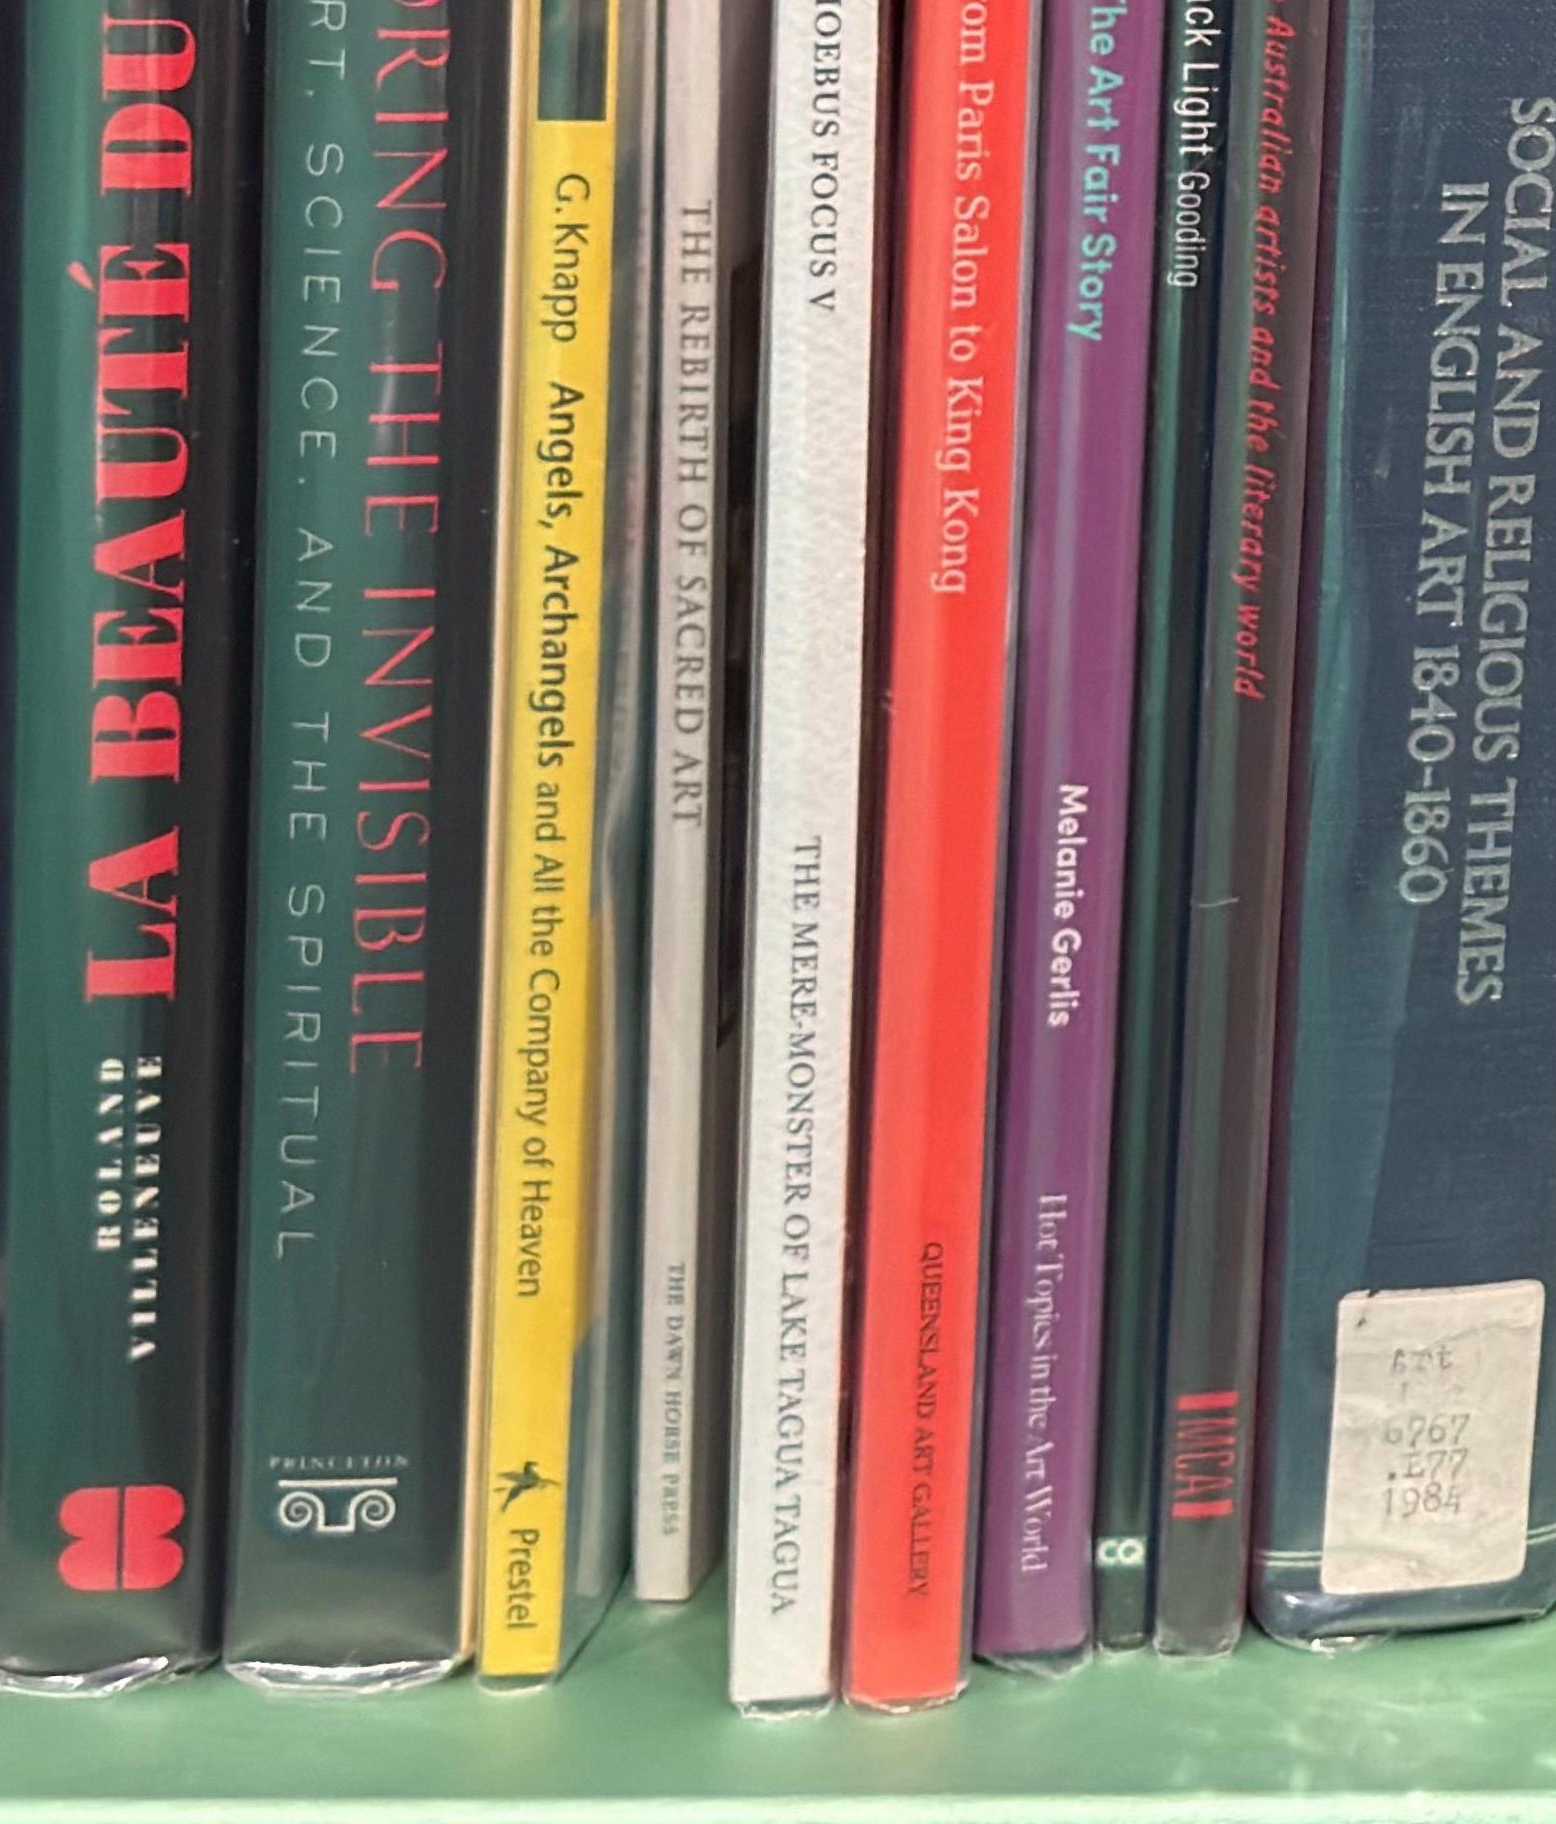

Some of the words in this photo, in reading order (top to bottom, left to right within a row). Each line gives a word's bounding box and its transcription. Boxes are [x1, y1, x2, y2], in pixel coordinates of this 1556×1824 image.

[101, 18, 195, 195] DU
[1085, 70, 1124, 130] Art
[1174, 60, 1216, 157] Light
[555, 174, 591, 214] G.
[680, 201, 710, 284] THE
[809, 152, 839, 278] FOCUS
[1083, 145, 1120, 221] Fair
[1168, 171, 1210, 287] Gooding
[1440, 182, 1488, 245] IN
[1500, 97, 1556, 307] SOCIAL
[542, 223, 588, 343] Knapp
[808, 290, 835, 312] V
[1070, 234, 1116, 342] Story
[365, 343, 441, 536] THE
[678, 303, 710, 484] REBIRTH
[1424, 262, 1482, 496] ENGLISH
[1493, 326, 1543, 458] AND
[67, 243, 190, 783] BEAUTÉ
[678, 502, 707, 552] OF
[1416, 517, 1466, 626] ART
[295, 529, 334, 668] AND
[675, 576, 707, 735] SACRED
[1473, 474, 1533, 762] RELIGIOUS
[290, 712, 328, 841] THE
[351, 587, 436, 1074] INVISIBLE
[673, 756, 705, 827] ART
[1397, 645, 1460, 905] 1840-1860
[85, 827, 179, 1001] LA
[793, 837, 821, 911] THE
[1056, 783, 1087, 919] Melanie
[1456, 780, 1515, 1005] THEMES
[1048, 927, 1082, 1027] Gerlis
[277, 886, 324, 1259] SPIRITUAL
[780, 922, 819, 1203] MERE-MONSTER
[97, 1057, 124, 1251] ROLAND
[130, 1055, 161, 1358] VILLENEUVE
[781, 1213, 812, 1259] OF
[780, 1266, 810, 1363] LAKE
[918, 1242, 942, 1426] QUEENSLAND
[774, 1369, 805, 1498] TAGUA
[914, 1433, 936, 1472] ART
[506, 1528, 540, 1630] Prestel
[770, 1503, 801, 1615] TAGUA
[907, 1478, 934, 1597] GALLERY
